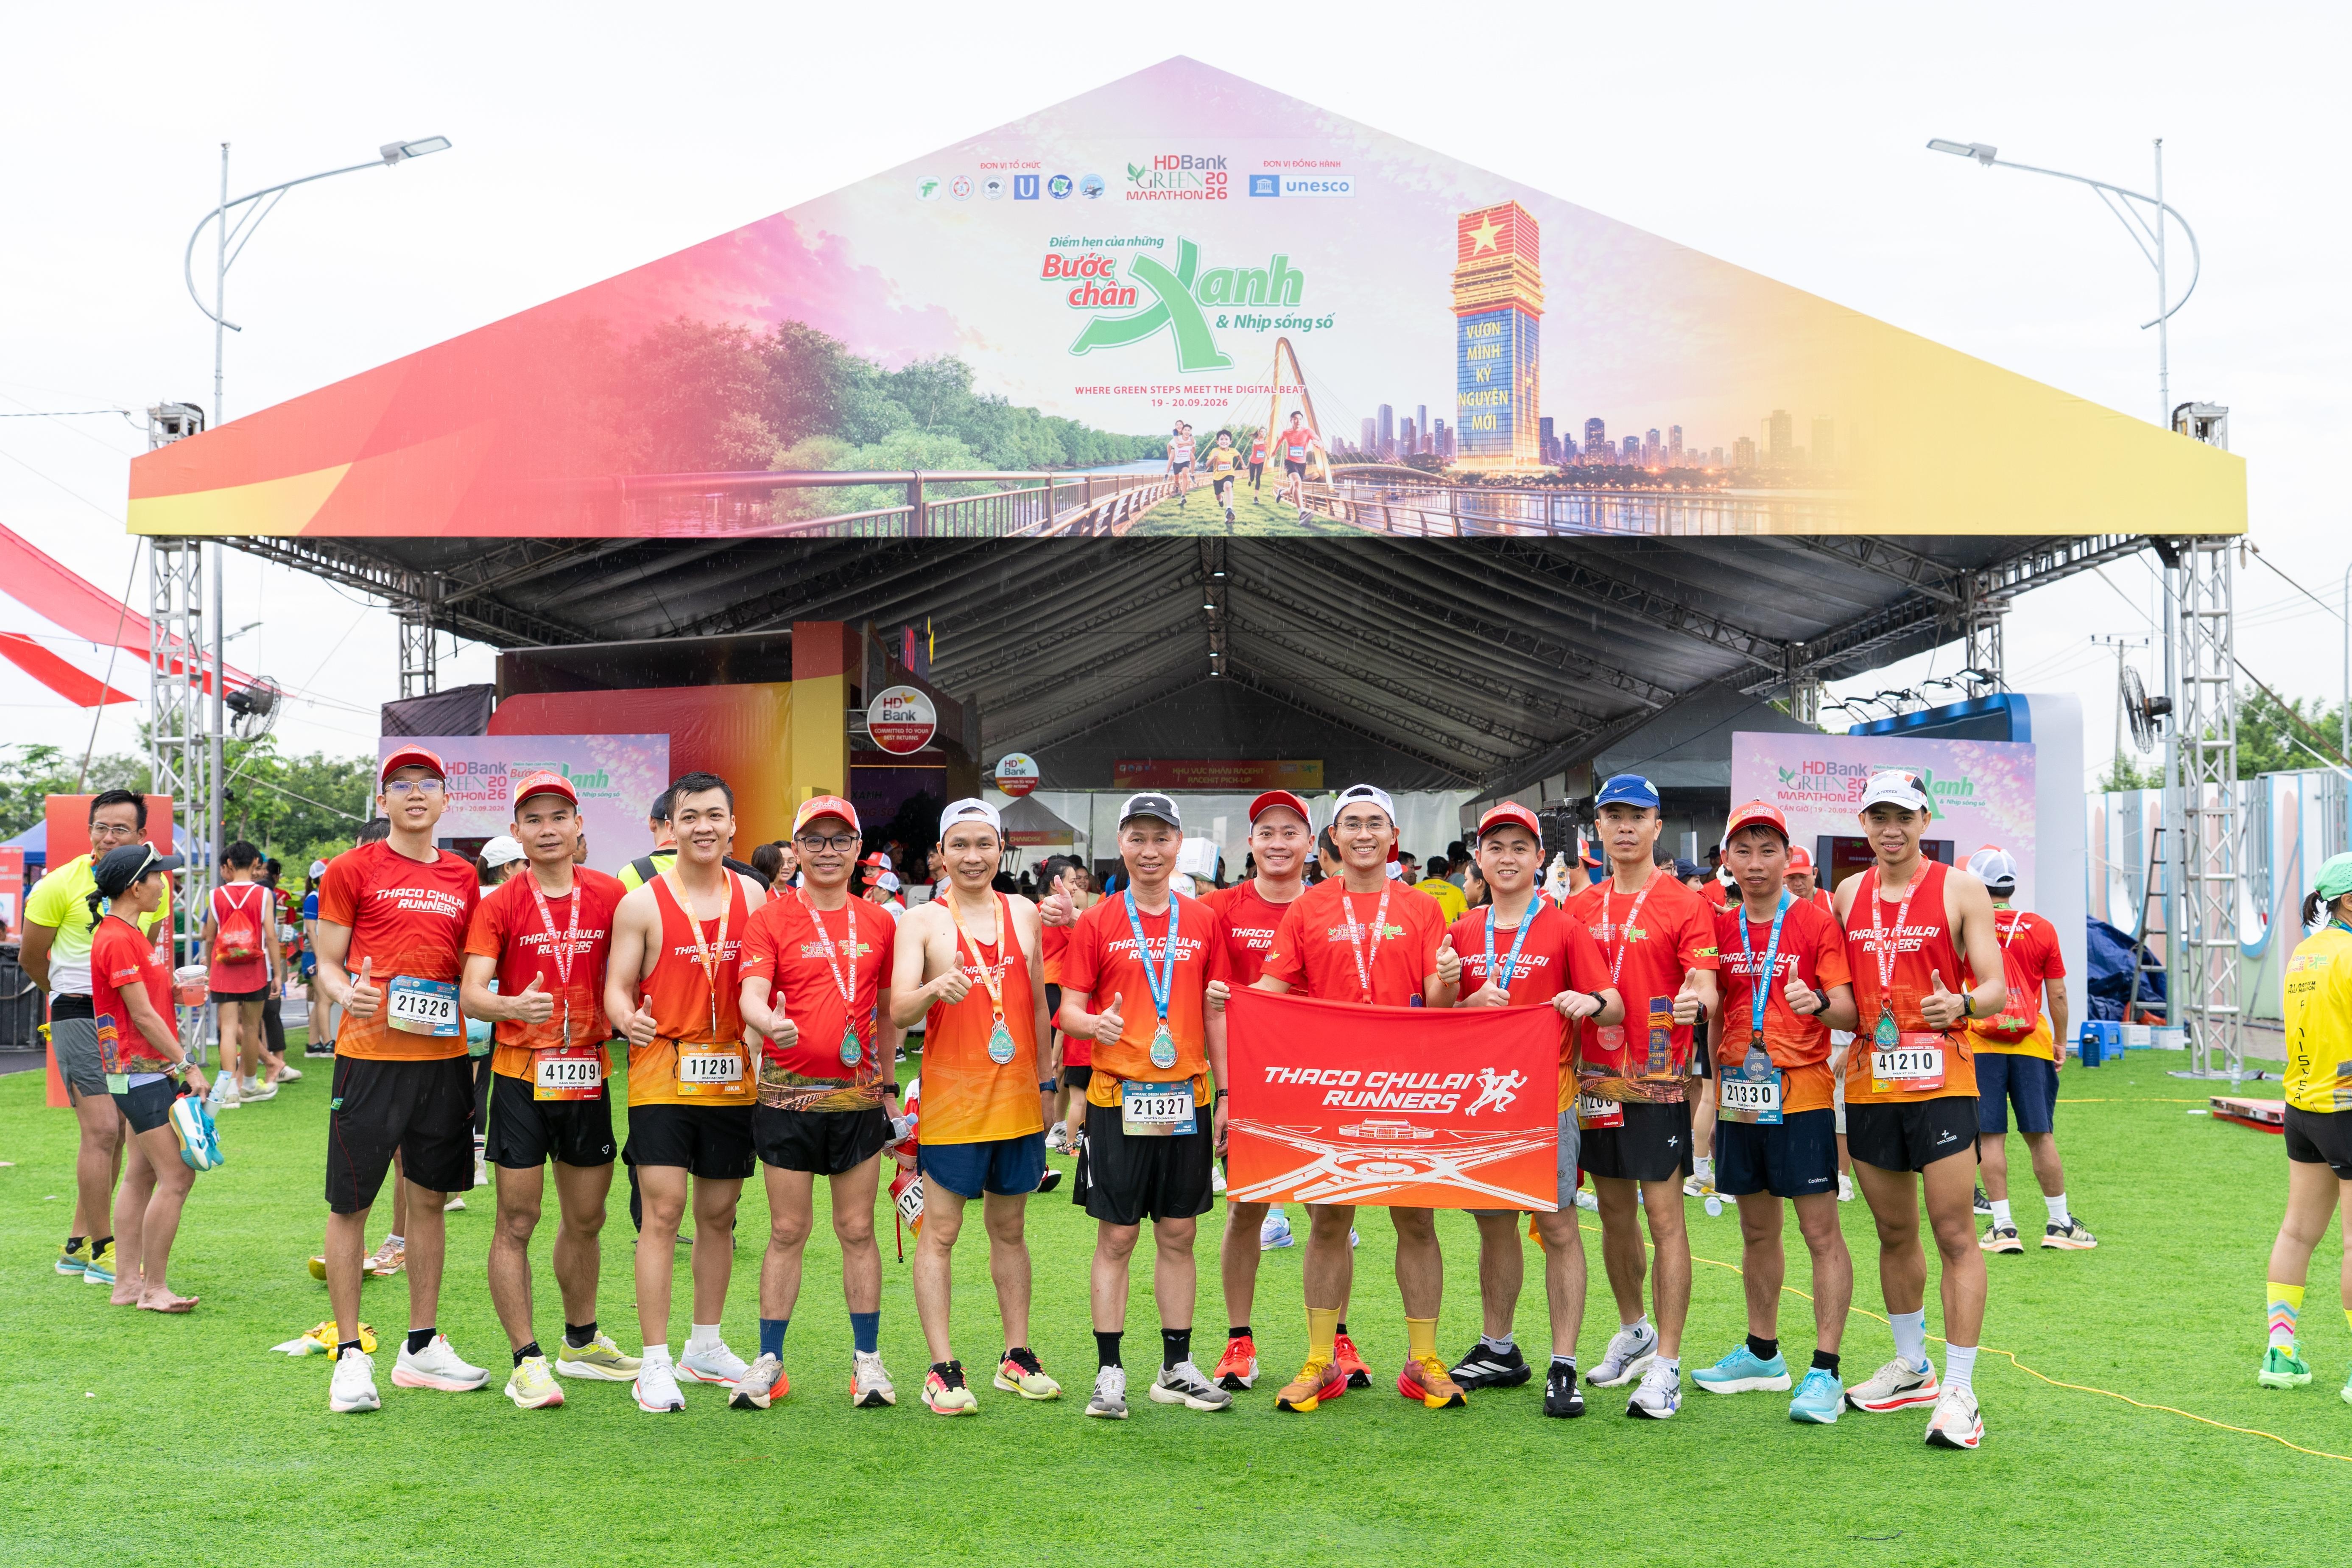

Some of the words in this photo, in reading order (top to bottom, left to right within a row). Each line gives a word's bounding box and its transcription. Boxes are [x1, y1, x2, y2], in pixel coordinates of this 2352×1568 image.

[1009, 159, 1020, 169] TỔ
[1154, 155, 1227, 170] HDBank
[1282, 161, 1291, 169] VỊ
[1293, 159, 1317, 167] ĐỒNG
[1319, 159, 1341, 167] HÀNH
[1136, 170, 1203, 189] GREEN
[1205, 172, 1227, 185] 20
[1286, 181, 1349, 192] unesco
[1126, 191, 1203, 200] MARATHON
[1205, 187, 1227, 200] 26
[1050, 235, 1079, 247] Điểm
[1082, 237, 1103, 249] hẹn
[1105, 236, 1125, 246] của
[1127, 236, 1164, 248] những
[1042, 252, 1114, 278] Bước
[1068, 281, 1137, 305] chân
[1216, 314, 1229, 328] &
[1234, 314, 1271, 333] Nhịp
[1274, 312, 1313, 332] sống
[1316, 312, 1336, 328] số
[1467, 321, 1500, 338] VƯƠN
[1467, 343, 1500, 361] MÌNH
[1476, 363, 1492, 382] KỶ
[1075, 386, 1111, 394] WHERE
[1114, 386, 1147, 394] GREEN
[1150, 386, 1181, 394] STEPS
[1213, 386, 1233, 394] THE
[1236, 386, 1276, 394] DIGITAL
[1279, 385, 1305, 394] BEAT
[1458, 388, 1508, 406] NGUYÊN
[1173, 399, 1228, 407] 20.09.2026
[1472, 412, 1496, 430] MỚI
[883, 698, 902, 709] HD
[883, 710, 916, 721] Bank
[445, 762, 507, 774] HDBank
[510, 768, 536, 778] Bướ
[1803, 761, 1867, 776] HDBank
[446, 777, 485, 791] REEN
[488, 777, 507, 787] 20
[1787, 773, 1846, 791] GREEN
[450, 792, 485, 800] ATHON
[488, 789, 507, 800] 26
[1777, 791, 1846, 802] MARATHON
[376, 888, 425, 900] THACO
[426, 889, 465, 910] CHULAI
[397, 899, 457, 918] RUNNERS
[1232, 928, 1275, 938] THACO
[1108, 938, 1155, 952] THAO
[1156, 937, 1201, 949] CULAI
[1129, 949, 1191, 961] RUNNRS
[1499, 953, 1550, 967] CULAI
[1757, 951, 1800, 964] CULAI
[553, 945, 566, 983] MARATHON
[1355, 950, 1368, 989] MARATHON
[1613, 945, 1625, 984] MARATHON
[1877, 948, 1888, 987] MARATHON
[832, 963, 847, 1000] MARATHON
[1502, 966, 1511, 988] RATHON
[1148, 971, 1160, 1001] MARATHON
[1757, 981, 1768, 1012] MARATHON
[397, 995, 449, 1017] 21328
[691, 1059, 734, 1075] 11281
[1879, 1053, 1932, 1070] 41210
[546, 1064, 595, 1080] 41209
[1264, 1066, 1359, 1087] THACO
[1365, 1071, 1475, 1090] CHULAI
[1727, 1084, 1771, 1103] 21330
[1134, 1098, 1184, 1115] 21327
[1322, 1091, 1461, 1114] RUNNERS
[900, 1178, 916, 1194] MARATHON
